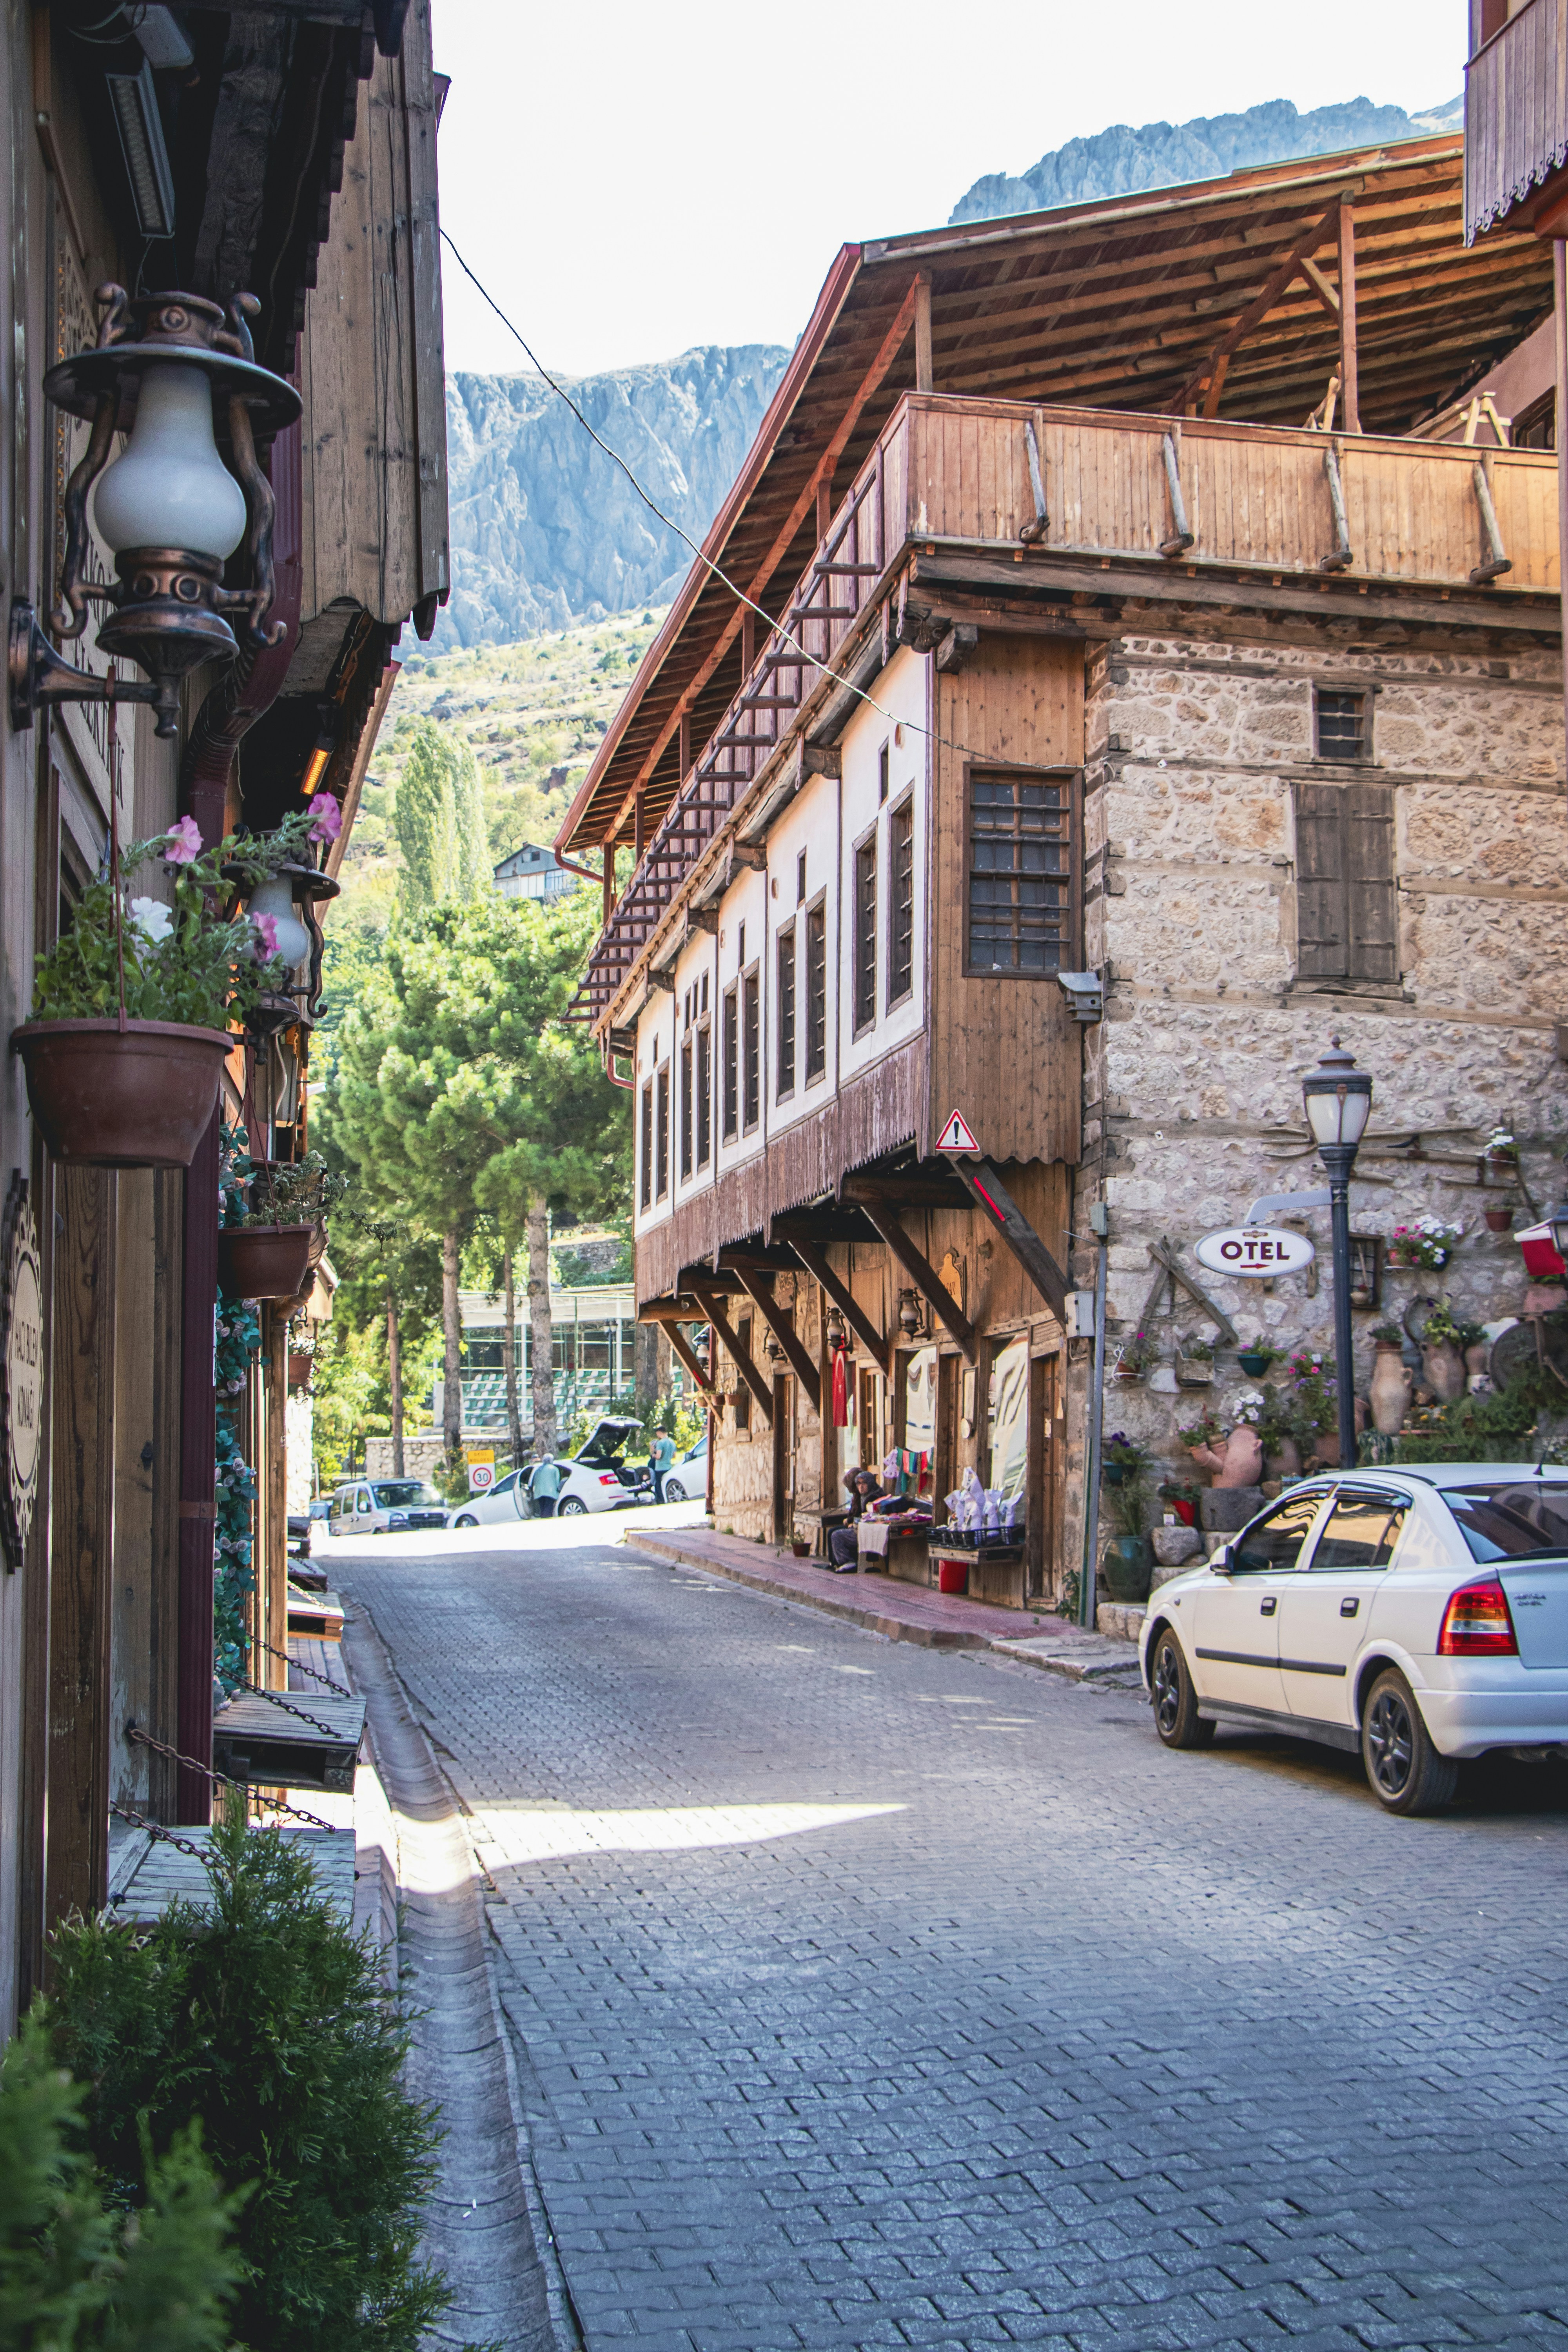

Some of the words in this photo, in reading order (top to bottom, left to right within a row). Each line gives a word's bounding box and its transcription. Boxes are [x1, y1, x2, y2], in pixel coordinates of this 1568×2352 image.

[1221, 1241, 1290, 1260] OTEL
[15, 1318, 25, 1362] HACI
[26, 1317, 38, 1367] BİLEN
[17, 1379, 34, 1429] KONAĞI
[477, 1473, 488, 1482] 30
